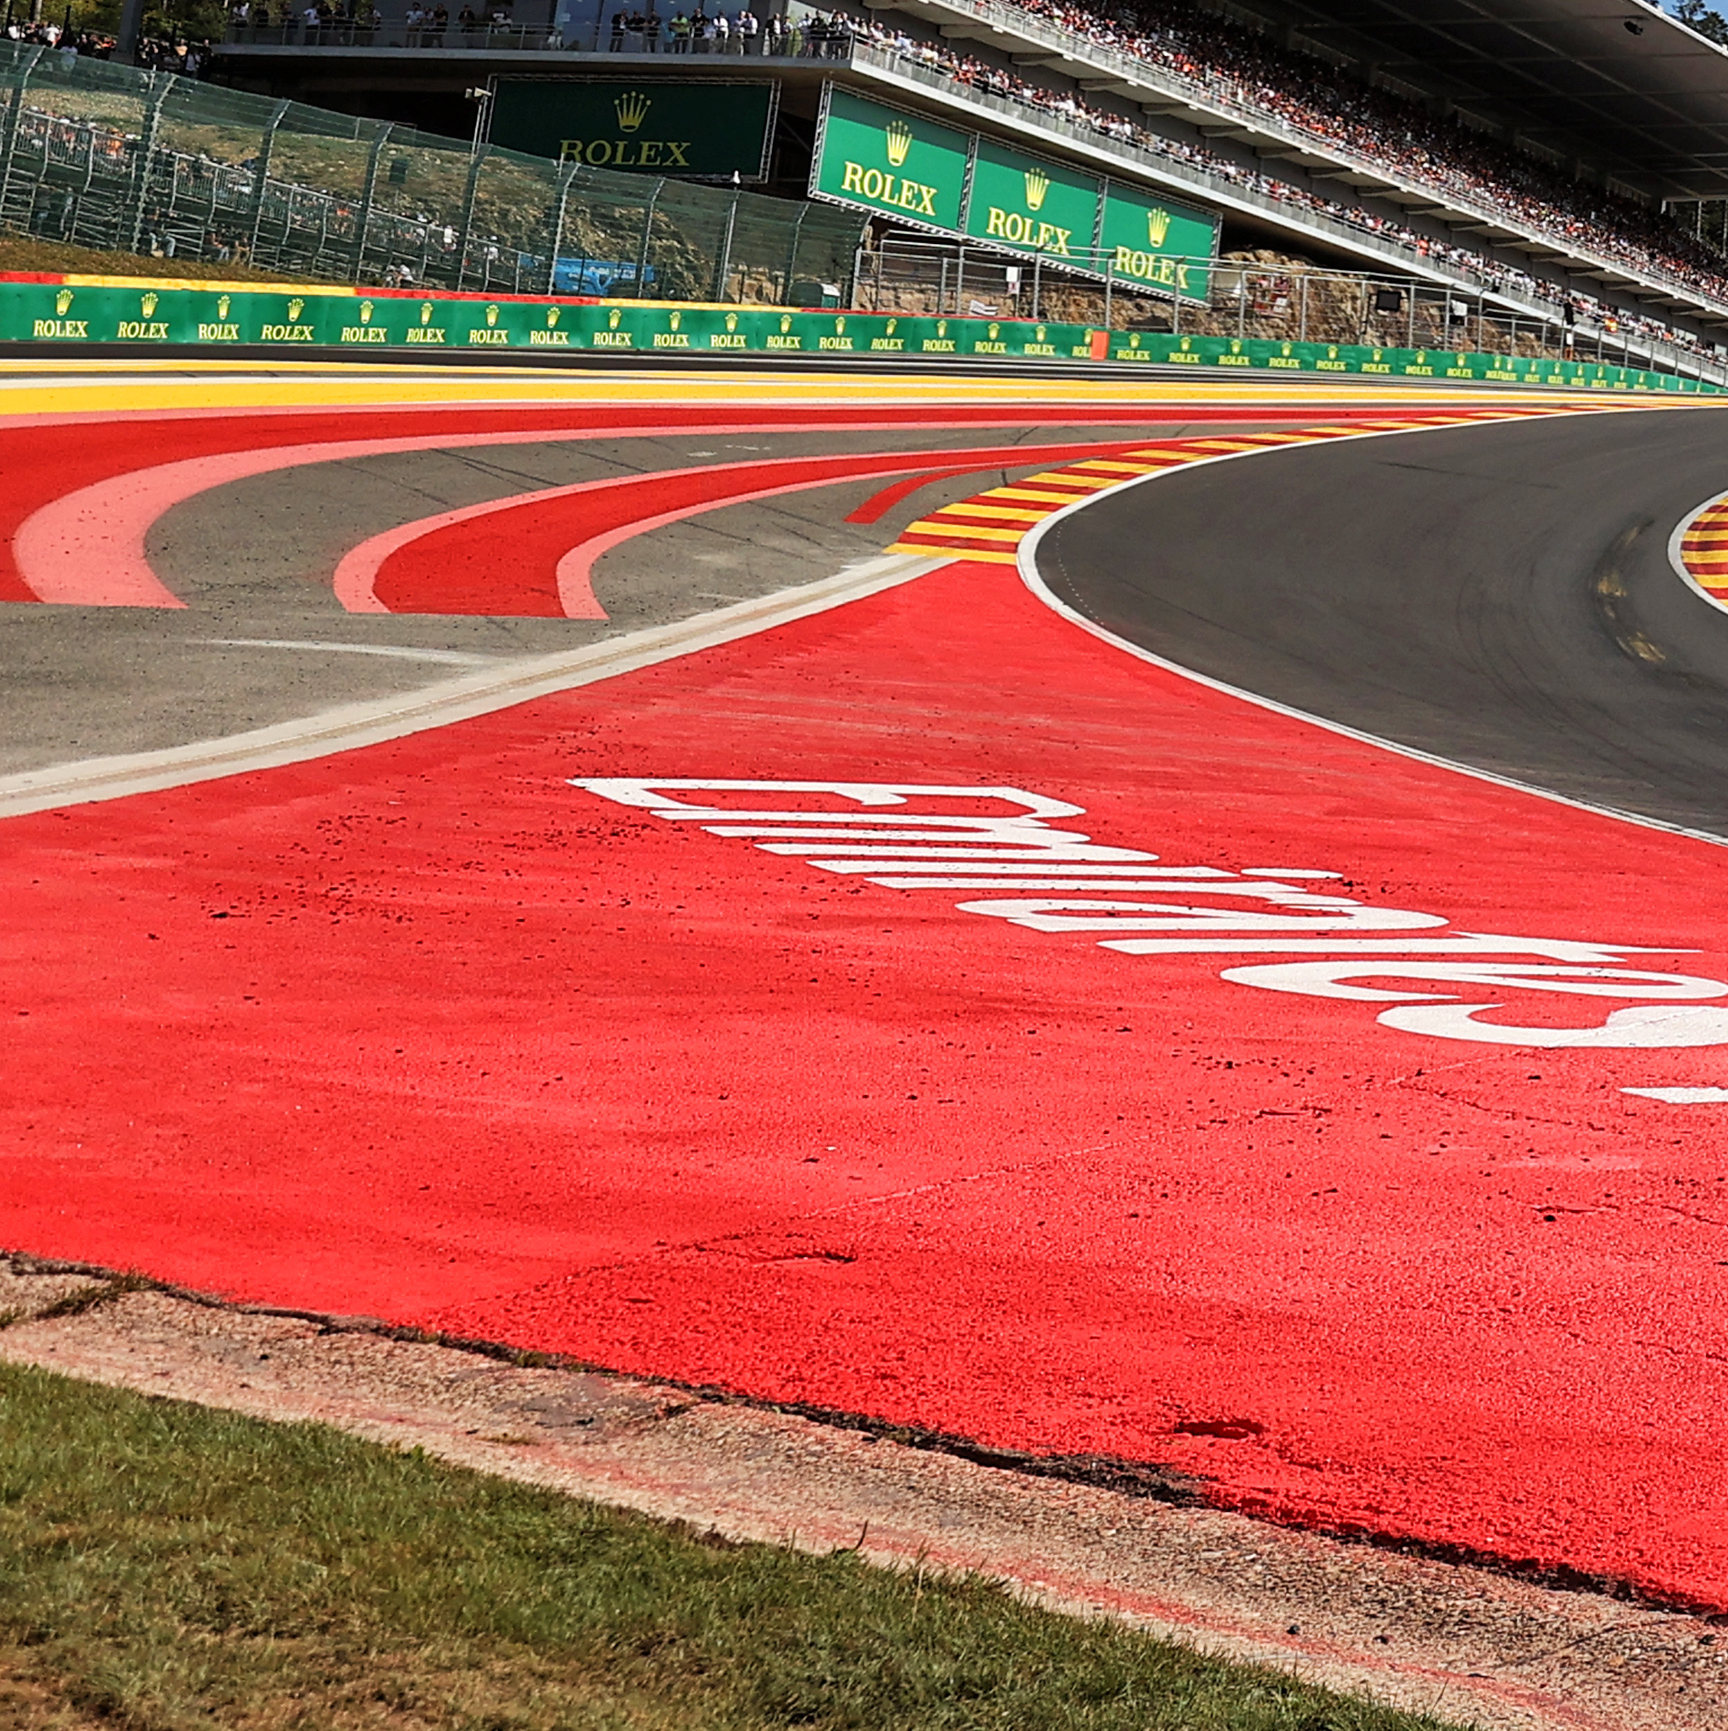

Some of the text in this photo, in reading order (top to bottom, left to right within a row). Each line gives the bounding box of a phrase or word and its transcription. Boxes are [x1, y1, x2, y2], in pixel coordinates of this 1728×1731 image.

[558, 139, 692, 167] ROLEX
[840, 161, 938, 217] ROLEX
[985, 206, 1073, 256] ROLEX
[1113, 244, 1190, 290] ROLEX
[33, 319, 89, 338] ROLEX
[117, 321, 169, 339] ROLEX
[198, 323, 239, 340] ROLEX
[260, 324, 314, 341] ROLEX
[340, 327, 388, 343] ROLEX
[405, 328, 446, 343] ROLEX
[469, 329, 508, 344] ROLEX
[529, 330, 569, 345] ROLEX
[593, 332, 632, 346] ROLEX
[653, 333, 690, 348] ROLEX
[710, 334, 746, 349] ROLEX
[766, 335, 801, 349] ROLEX
[819, 336, 853, 350] ROLEX
[870, 338, 904, 351] ROLEX
[922, 339, 956, 352] ROLEX
[974, 341, 1007, 354] ROLEX
[1023, 343, 1055, 356] ROLEX
